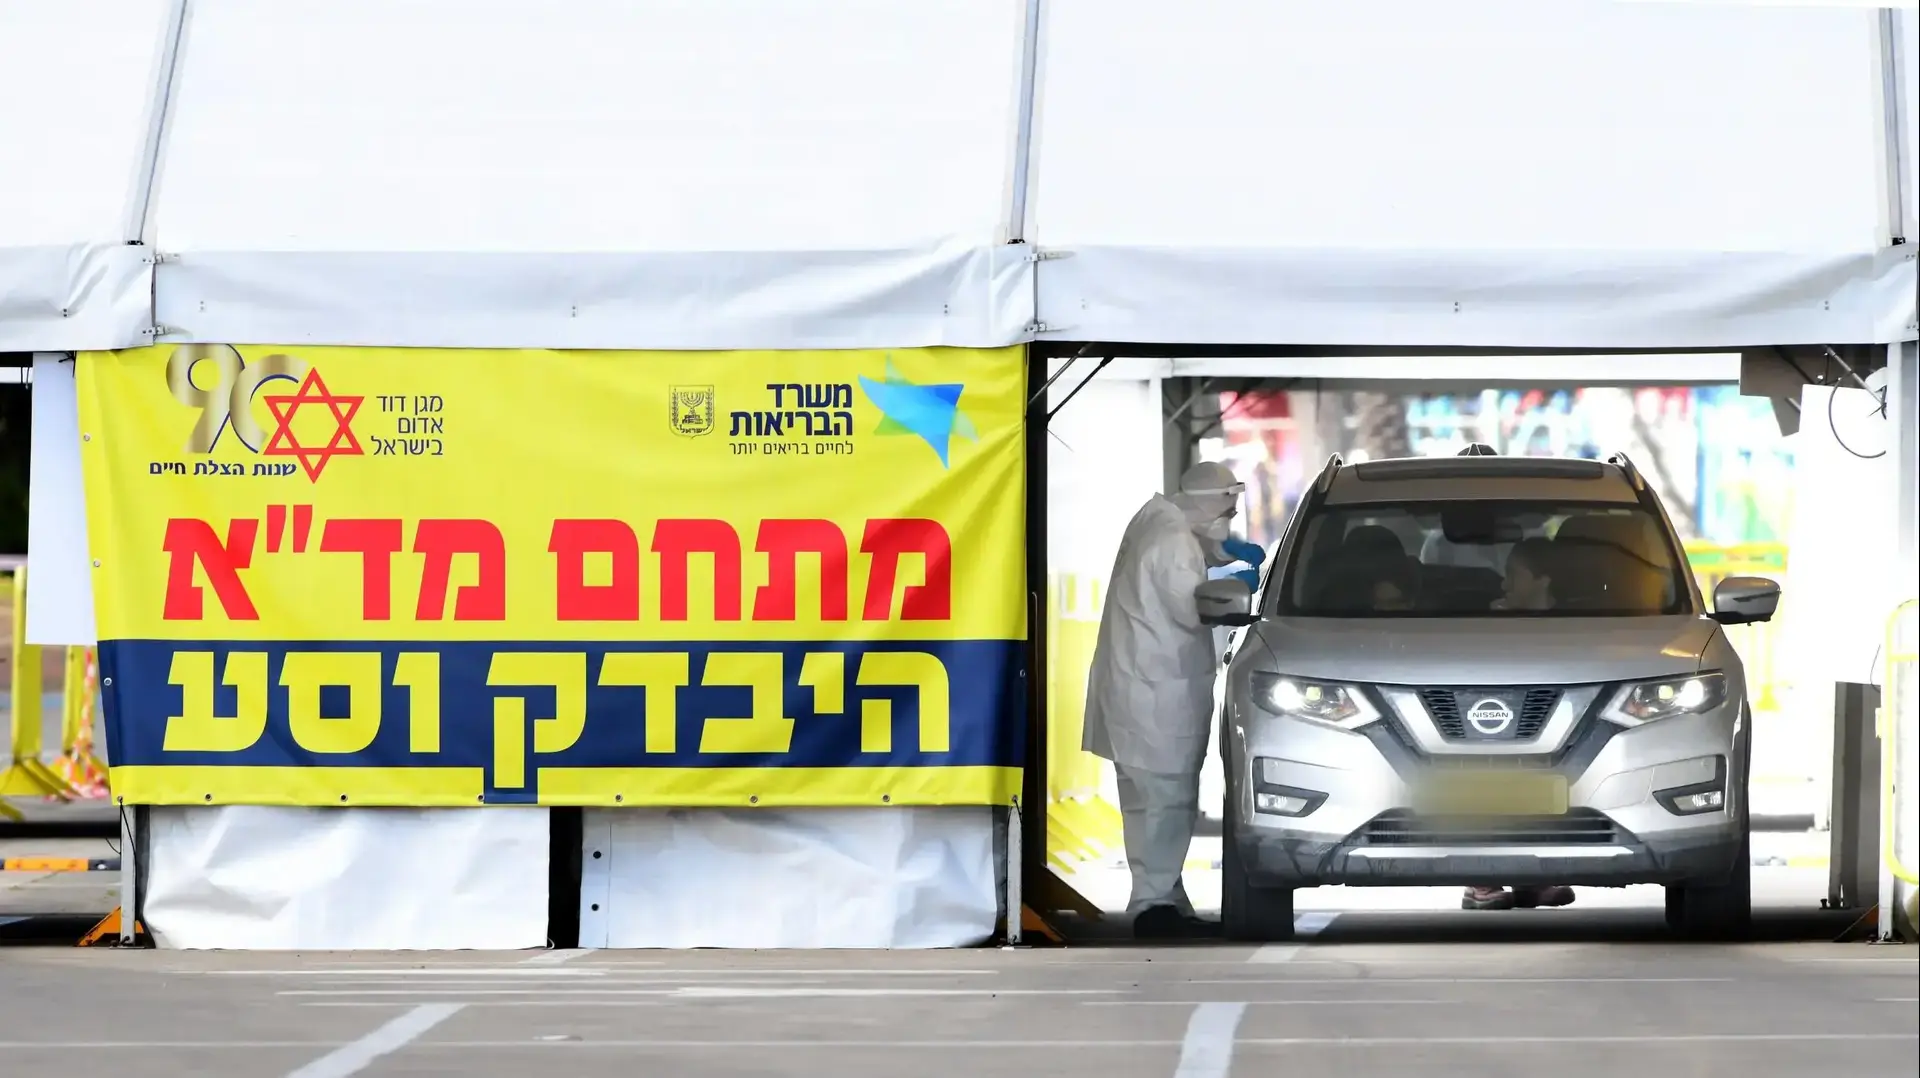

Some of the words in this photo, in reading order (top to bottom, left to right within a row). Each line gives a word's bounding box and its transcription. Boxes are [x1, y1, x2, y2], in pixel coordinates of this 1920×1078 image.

[376, 395, 407, 412] דוד
[766, 383, 853, 409] משרד
[414, 395, 444, 417] מגן
[398, 417, 444, 434] אדום
[729, 410, 853, 437] הבריאות
[370, 435, 444, 456] בישראל
[729, 442, 757, 455] יותר
[763, 442, 810, 455] בריאים
[815, 440, 854, 455] לחיים
[149, 462, 187, 476] חיים
[193, 461, 245, 476] הצלת
[251, 462, 298, 477] שנות
[162, 503, 506, 621] מד"א
[547, 518, 952, 621] מתחם
[162, 651, 440, 754] וסע
[484, 651, 950, 790] היבדק
